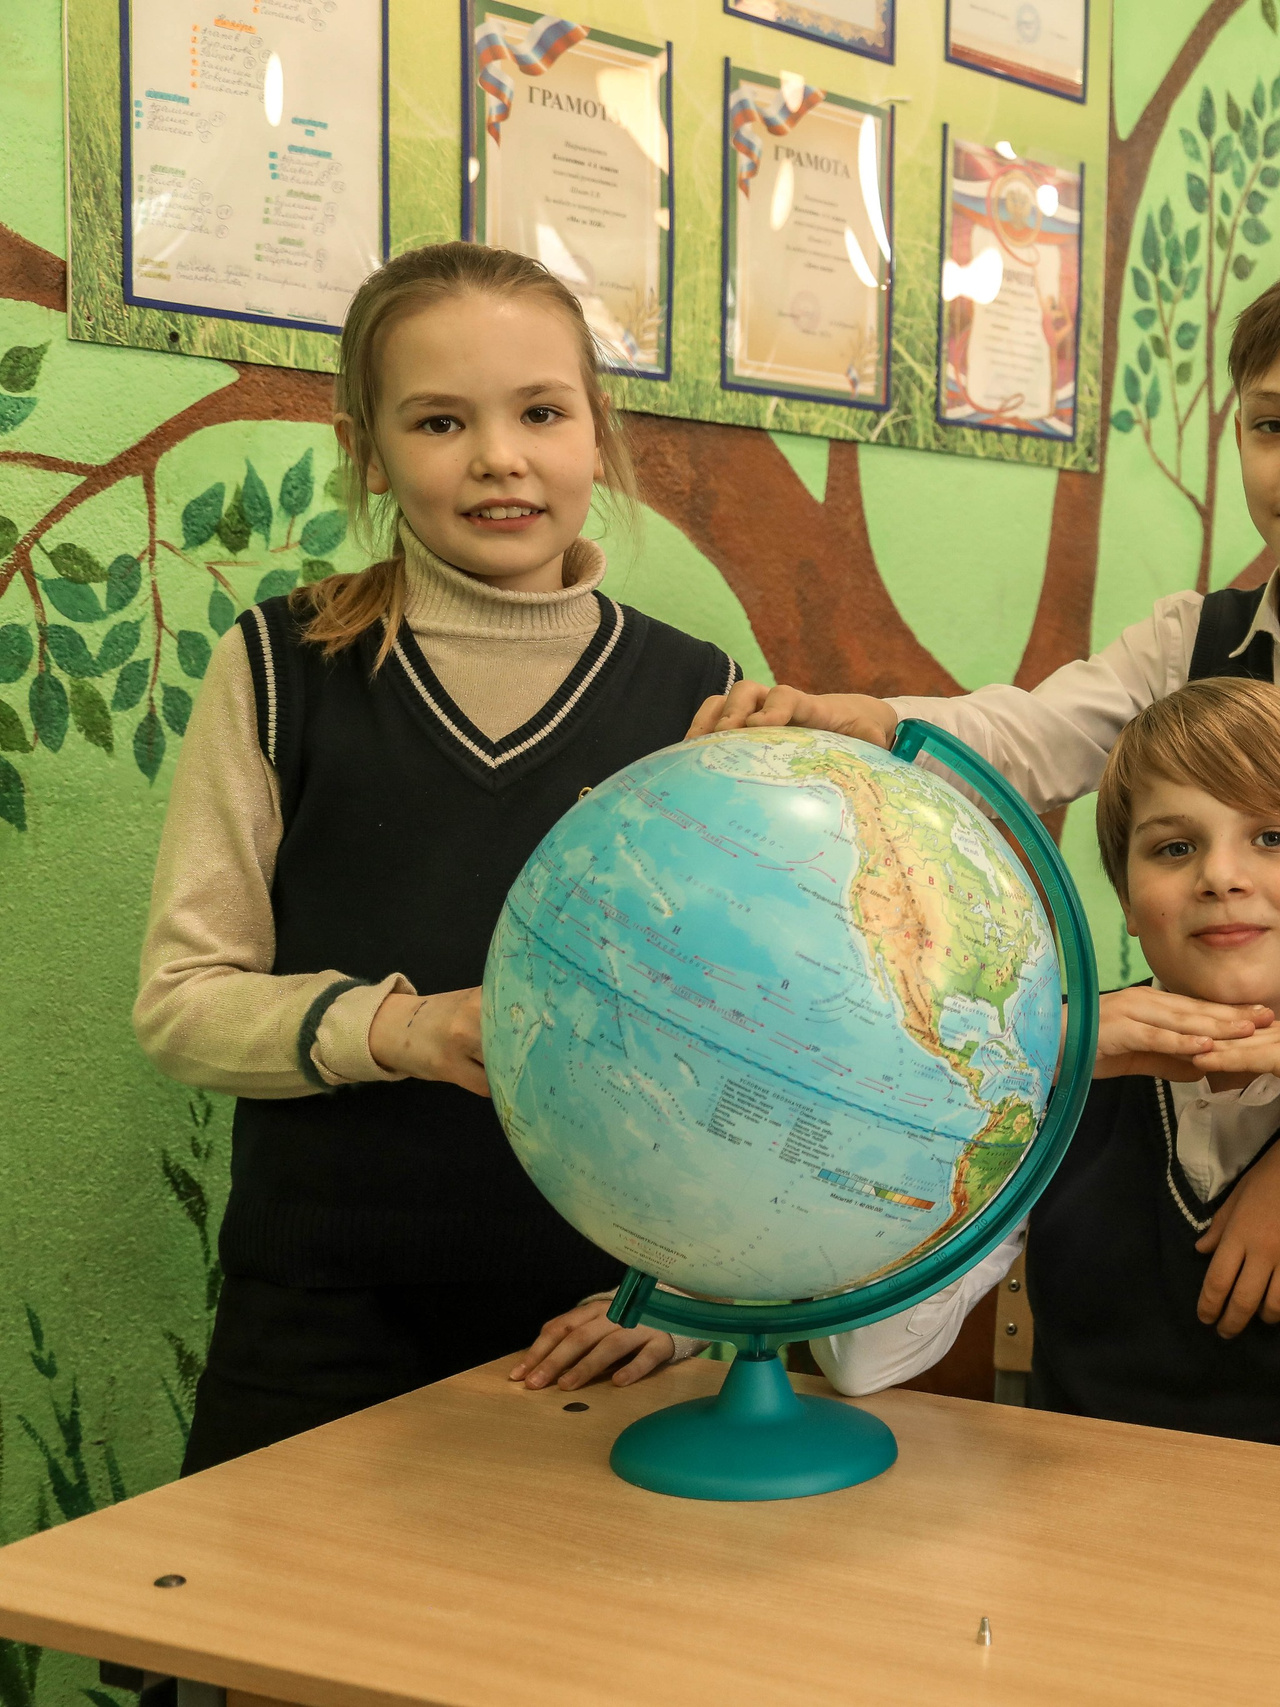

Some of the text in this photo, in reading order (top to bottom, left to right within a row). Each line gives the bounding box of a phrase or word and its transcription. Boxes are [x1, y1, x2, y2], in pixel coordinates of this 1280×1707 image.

[527, 85, 614, 123] ГРАМОТ
[772, 144, 852, 179] ГРАМОТА
[884, 857, 1020, 920] СЕВЕРНАЯ
[903, 930, 1016, 984] АМЕРИКА
